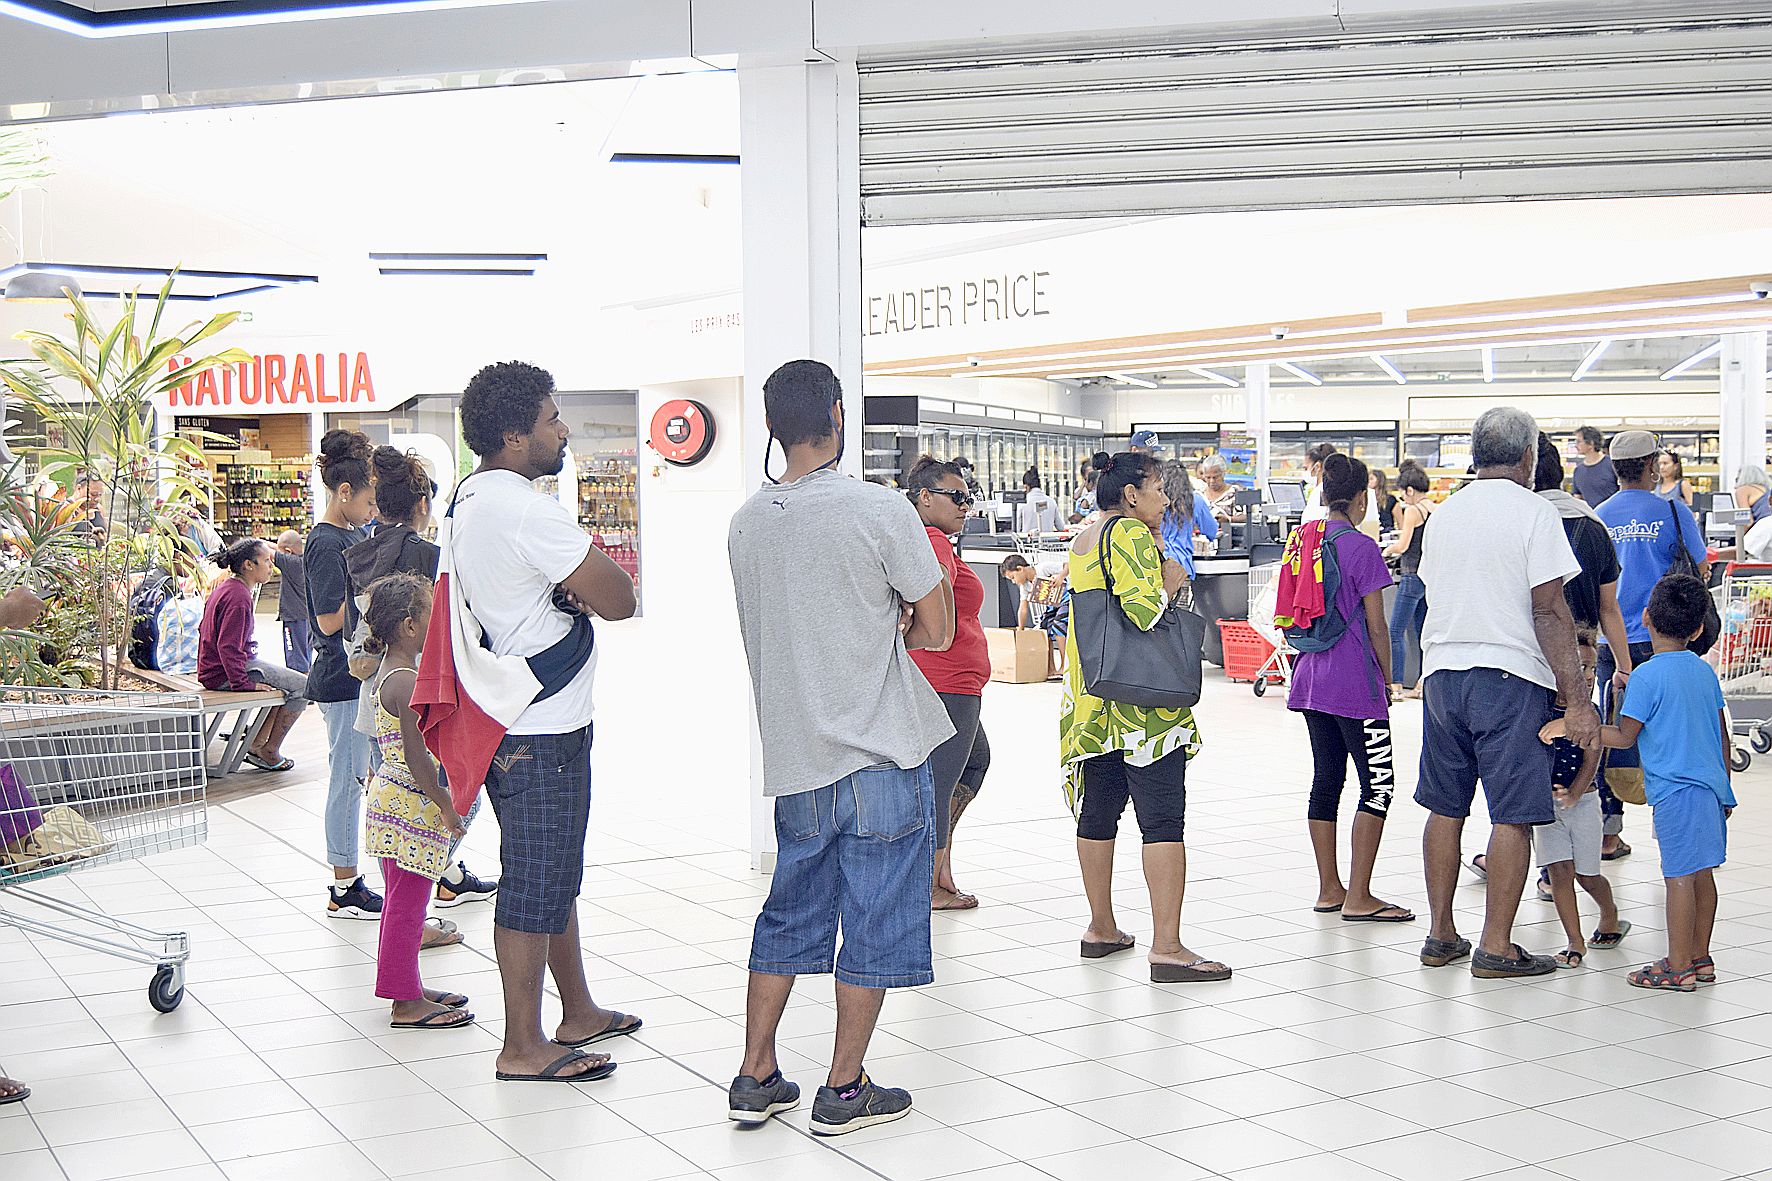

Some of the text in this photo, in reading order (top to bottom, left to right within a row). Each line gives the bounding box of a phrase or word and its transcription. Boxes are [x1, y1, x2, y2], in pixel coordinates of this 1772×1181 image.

[862, 271, 1050, 337] EADER PRICE
[178, 417, 191, 427] SANS
